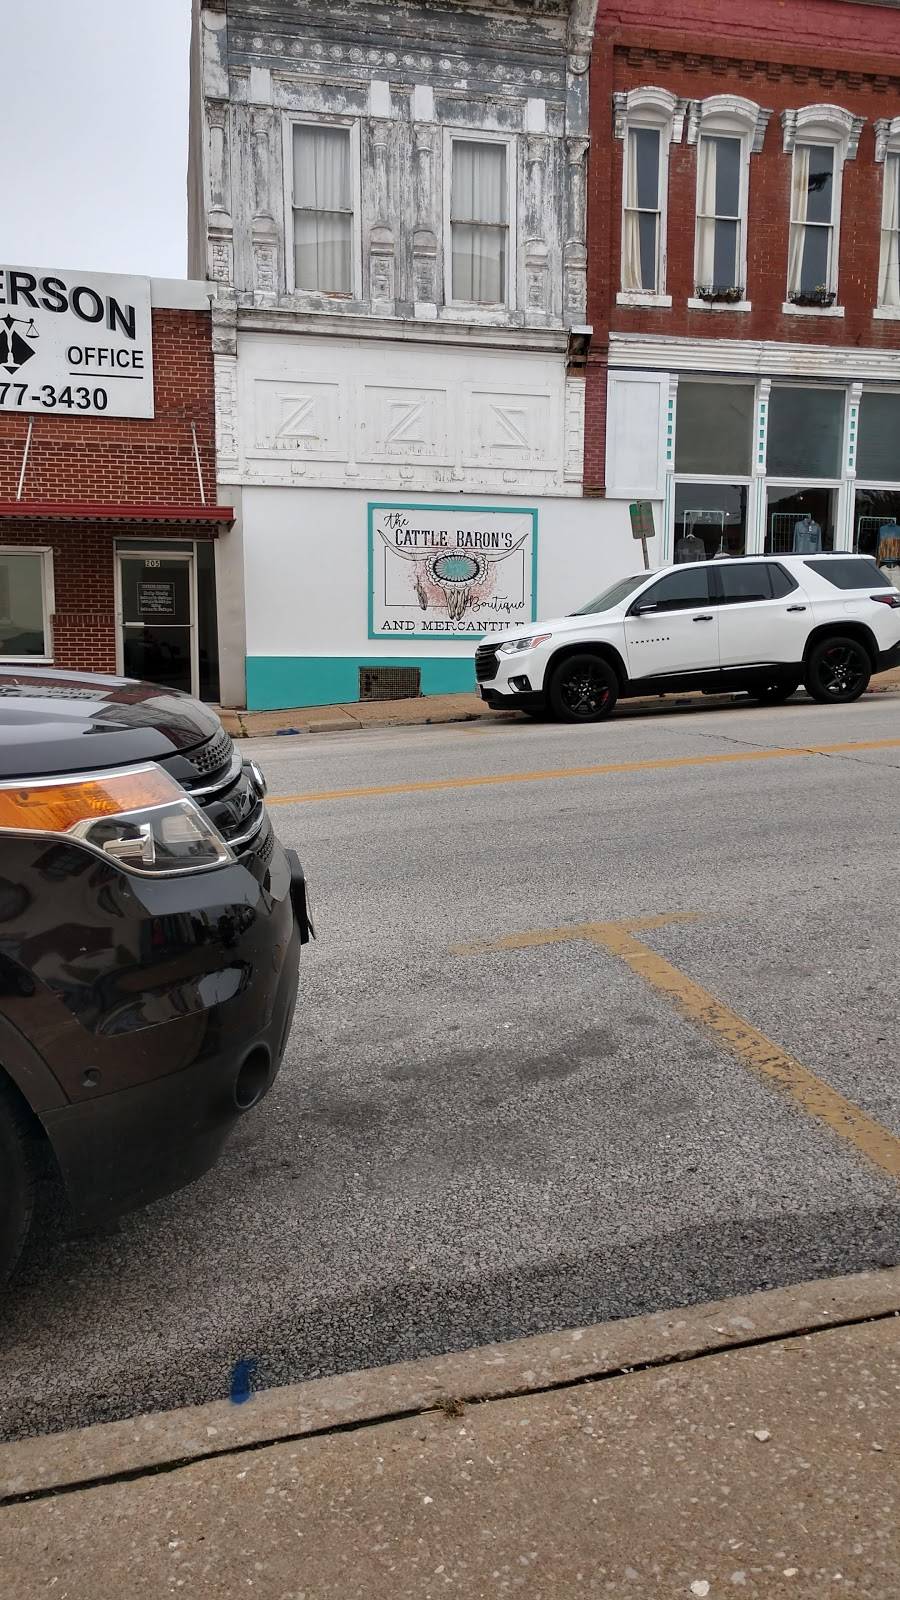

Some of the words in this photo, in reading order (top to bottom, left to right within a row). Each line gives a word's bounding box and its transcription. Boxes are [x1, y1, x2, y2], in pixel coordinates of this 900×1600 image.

[0, 270, 136, 340] RSON
[67, 345, 144, 369] OFFICE
[0, 383, 108, 410] 77-3430
[383, 512, 409, 530] the
[395, 529, 448, 547] CATTLE
[456, 530, 513, 548] BARON'S
[465, 596, 525, 614] Boutique
[381, 620, 416, 631] AND
